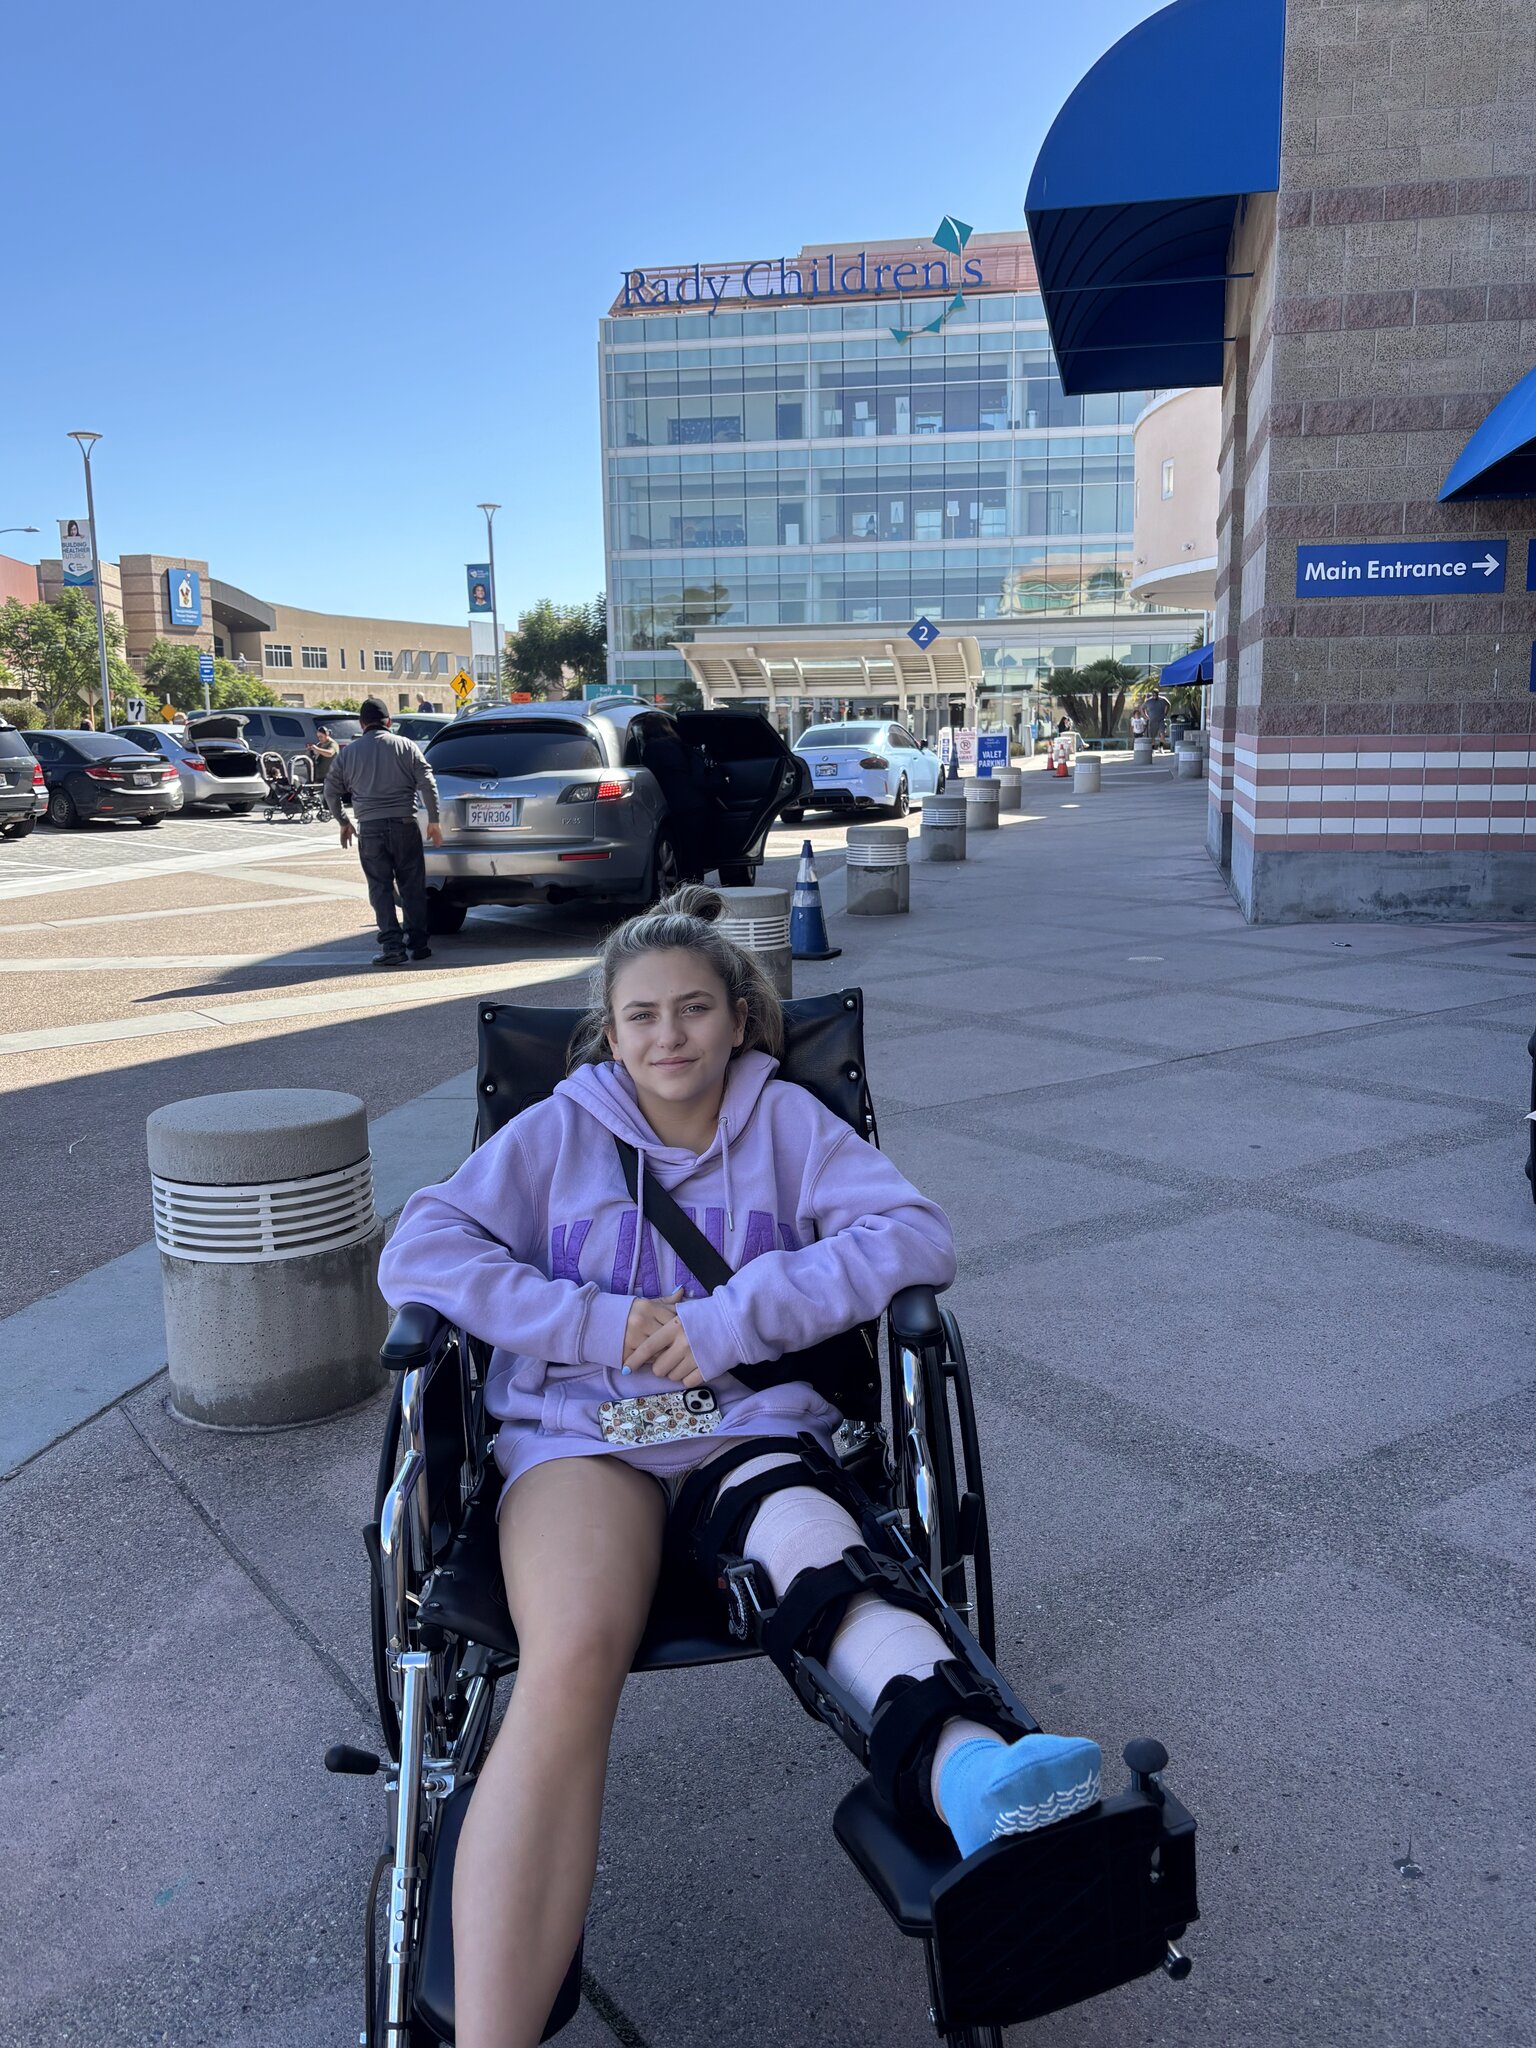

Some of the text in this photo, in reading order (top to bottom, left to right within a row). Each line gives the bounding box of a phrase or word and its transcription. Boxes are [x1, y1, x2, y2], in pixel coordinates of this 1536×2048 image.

[620, 262, 731, 316] Rady
[1304, 560, 1467, 581] Main Entrance
[919, 626, 928, 641] 2
[982, 750, 1002, 759] VALET
[978, 759, 1005, 768] PARKING
[471, 811, 511, 823] 9FVR306
